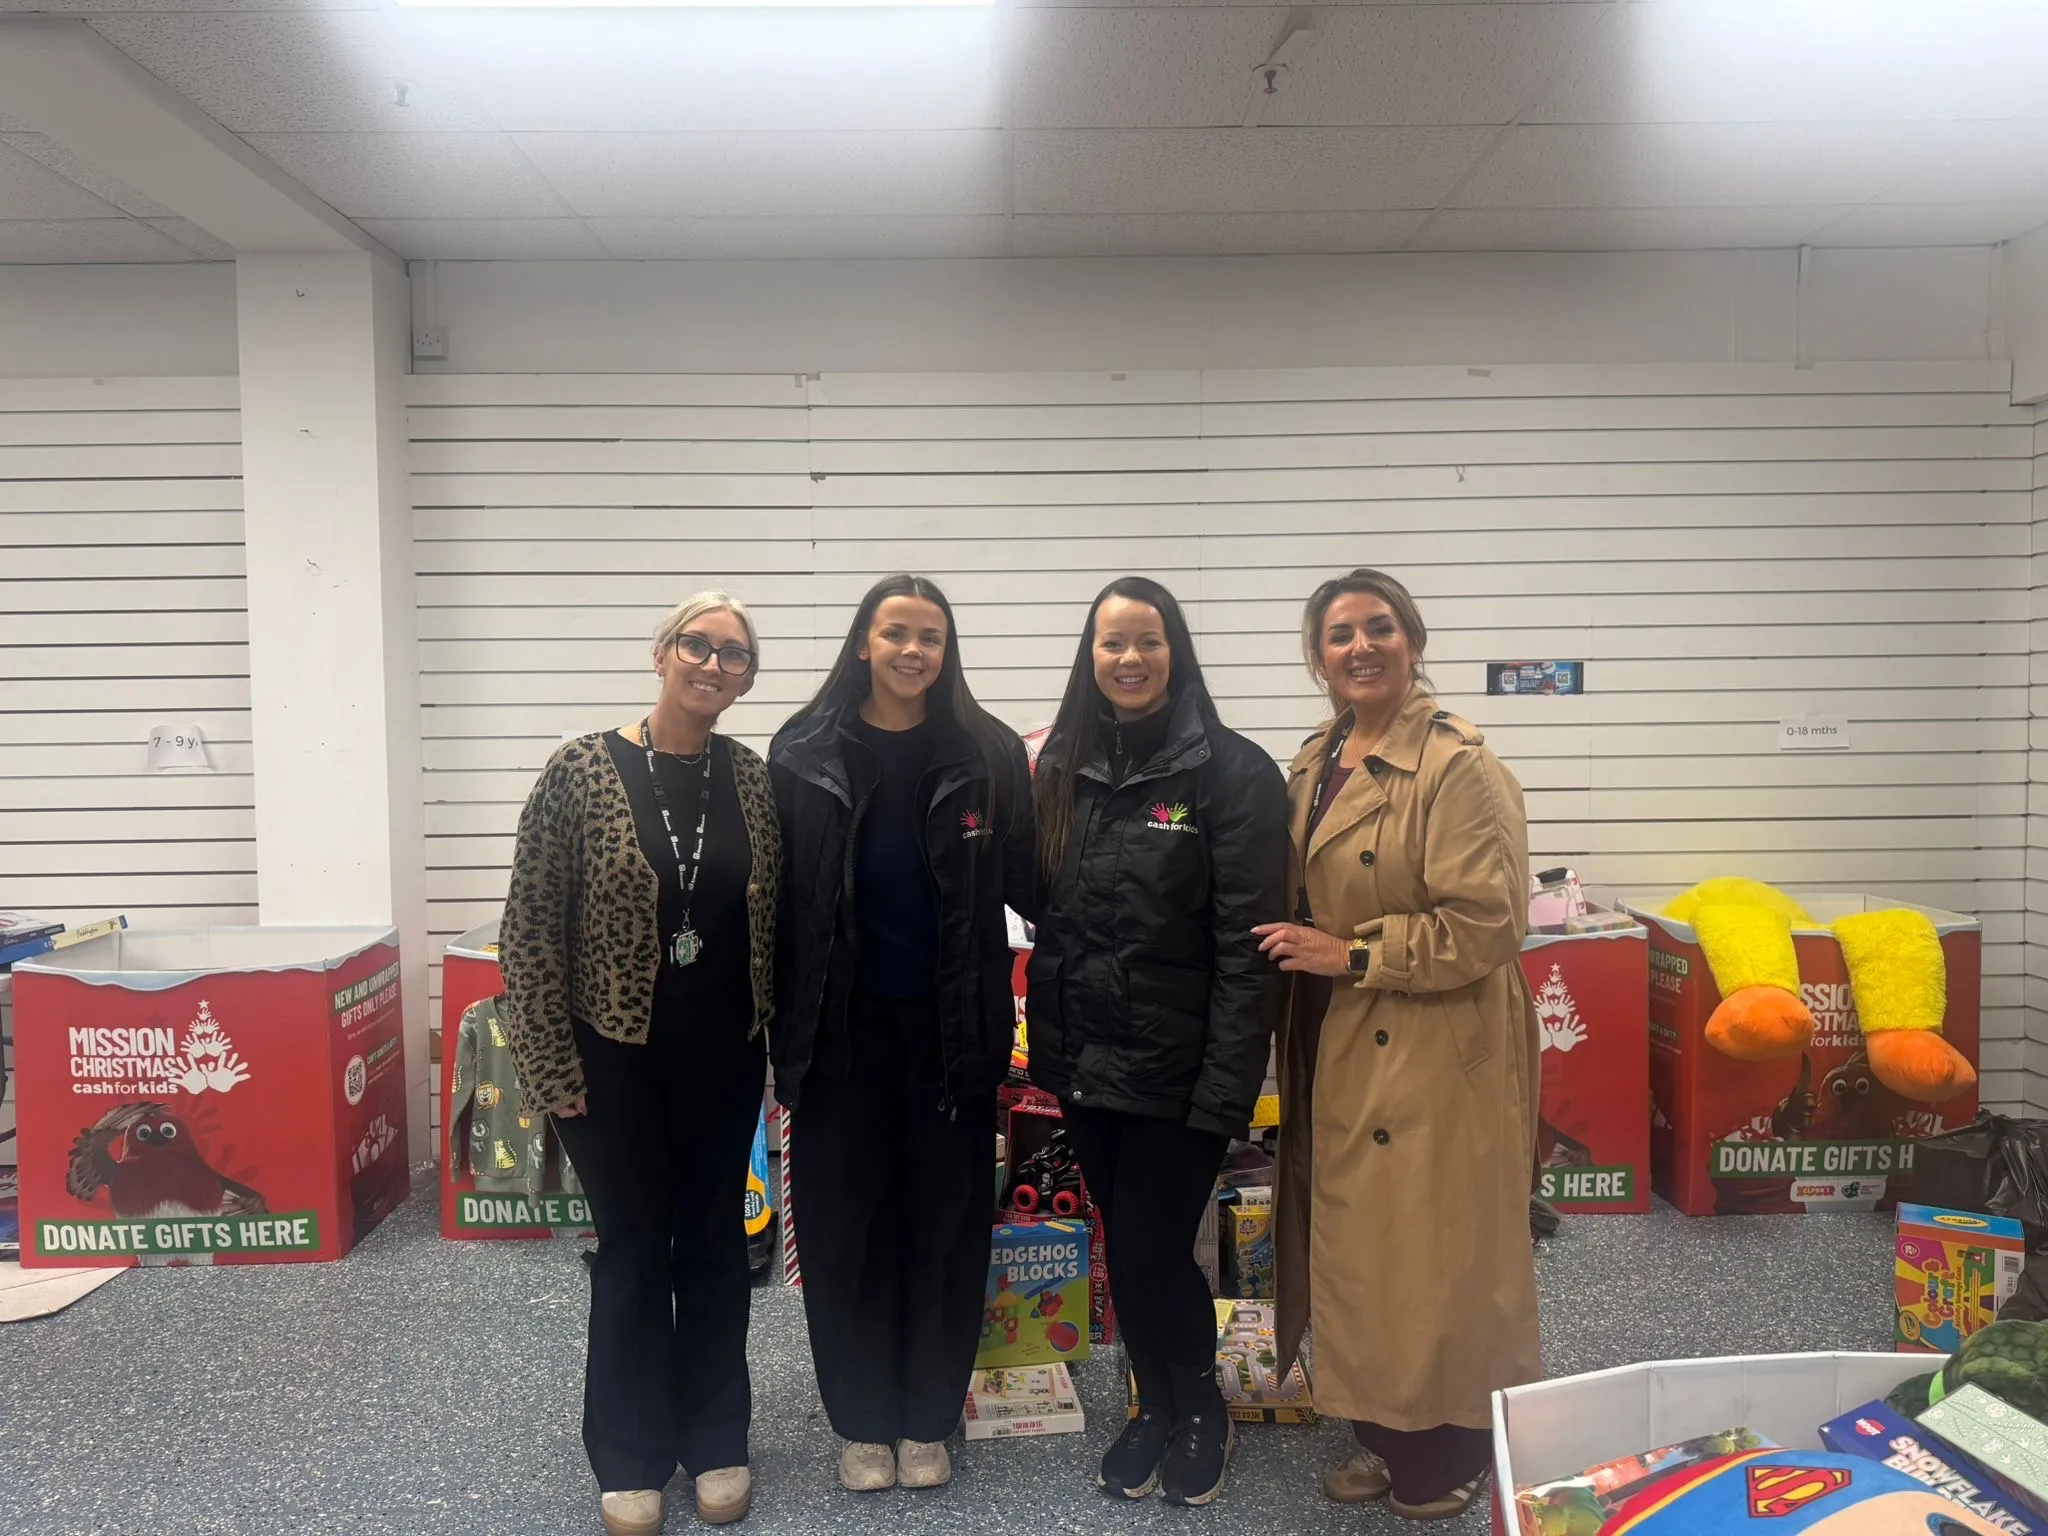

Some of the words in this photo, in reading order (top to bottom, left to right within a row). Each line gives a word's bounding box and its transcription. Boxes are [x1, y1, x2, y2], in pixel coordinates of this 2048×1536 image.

[153, 736, 161, 748] 7
[175, 735, 184, 747] 9
[1786, 726, 1808, 736] 0-18
[1811, 725, 1838, 735] mths
[1649, 949, 1688, 975] WRAPPED
[1651, 969, 1682, 994] PLEASE
[335, 988, 352, 1010] NEW
[353, 981, 368, 1001] AND
[1800, 983, 1853, 1011] SSIO
[341, 1005, 362, 1028] GIFTS
[362, 994, 380, 1017] ONLY
[68, 1026, 176, 1057] MISSION
[70, 1056, 177, 1079] CHRISTMAS
[72, 1081, 178, 1095] cashforkids
[1719, 1146, 1817, 1172] DONATE
[1823, 1145, 1892, 1171] GIFTS
[1563, 1171, 1626, 1197] HERE
[464, 1197, 561, 1224] DONATE
[43, 1224, 149, 1251] DONATE
[155, 1222, 232, 1248] GIFTS
[238, 1218, 310, 1247] HERE
[991, 1243, 1079, 1265] EDGEHOG
[1007, 1261, 1079, 1283] BLOCKS
[1922, 1271, 1943, 1328] Colour
[1939, 1271, 1956, 1318] Craft
[1856, 1418, 1881, 1436] HOOT
[1889, 1436, 2033, 1536] SNOWFLAKE
